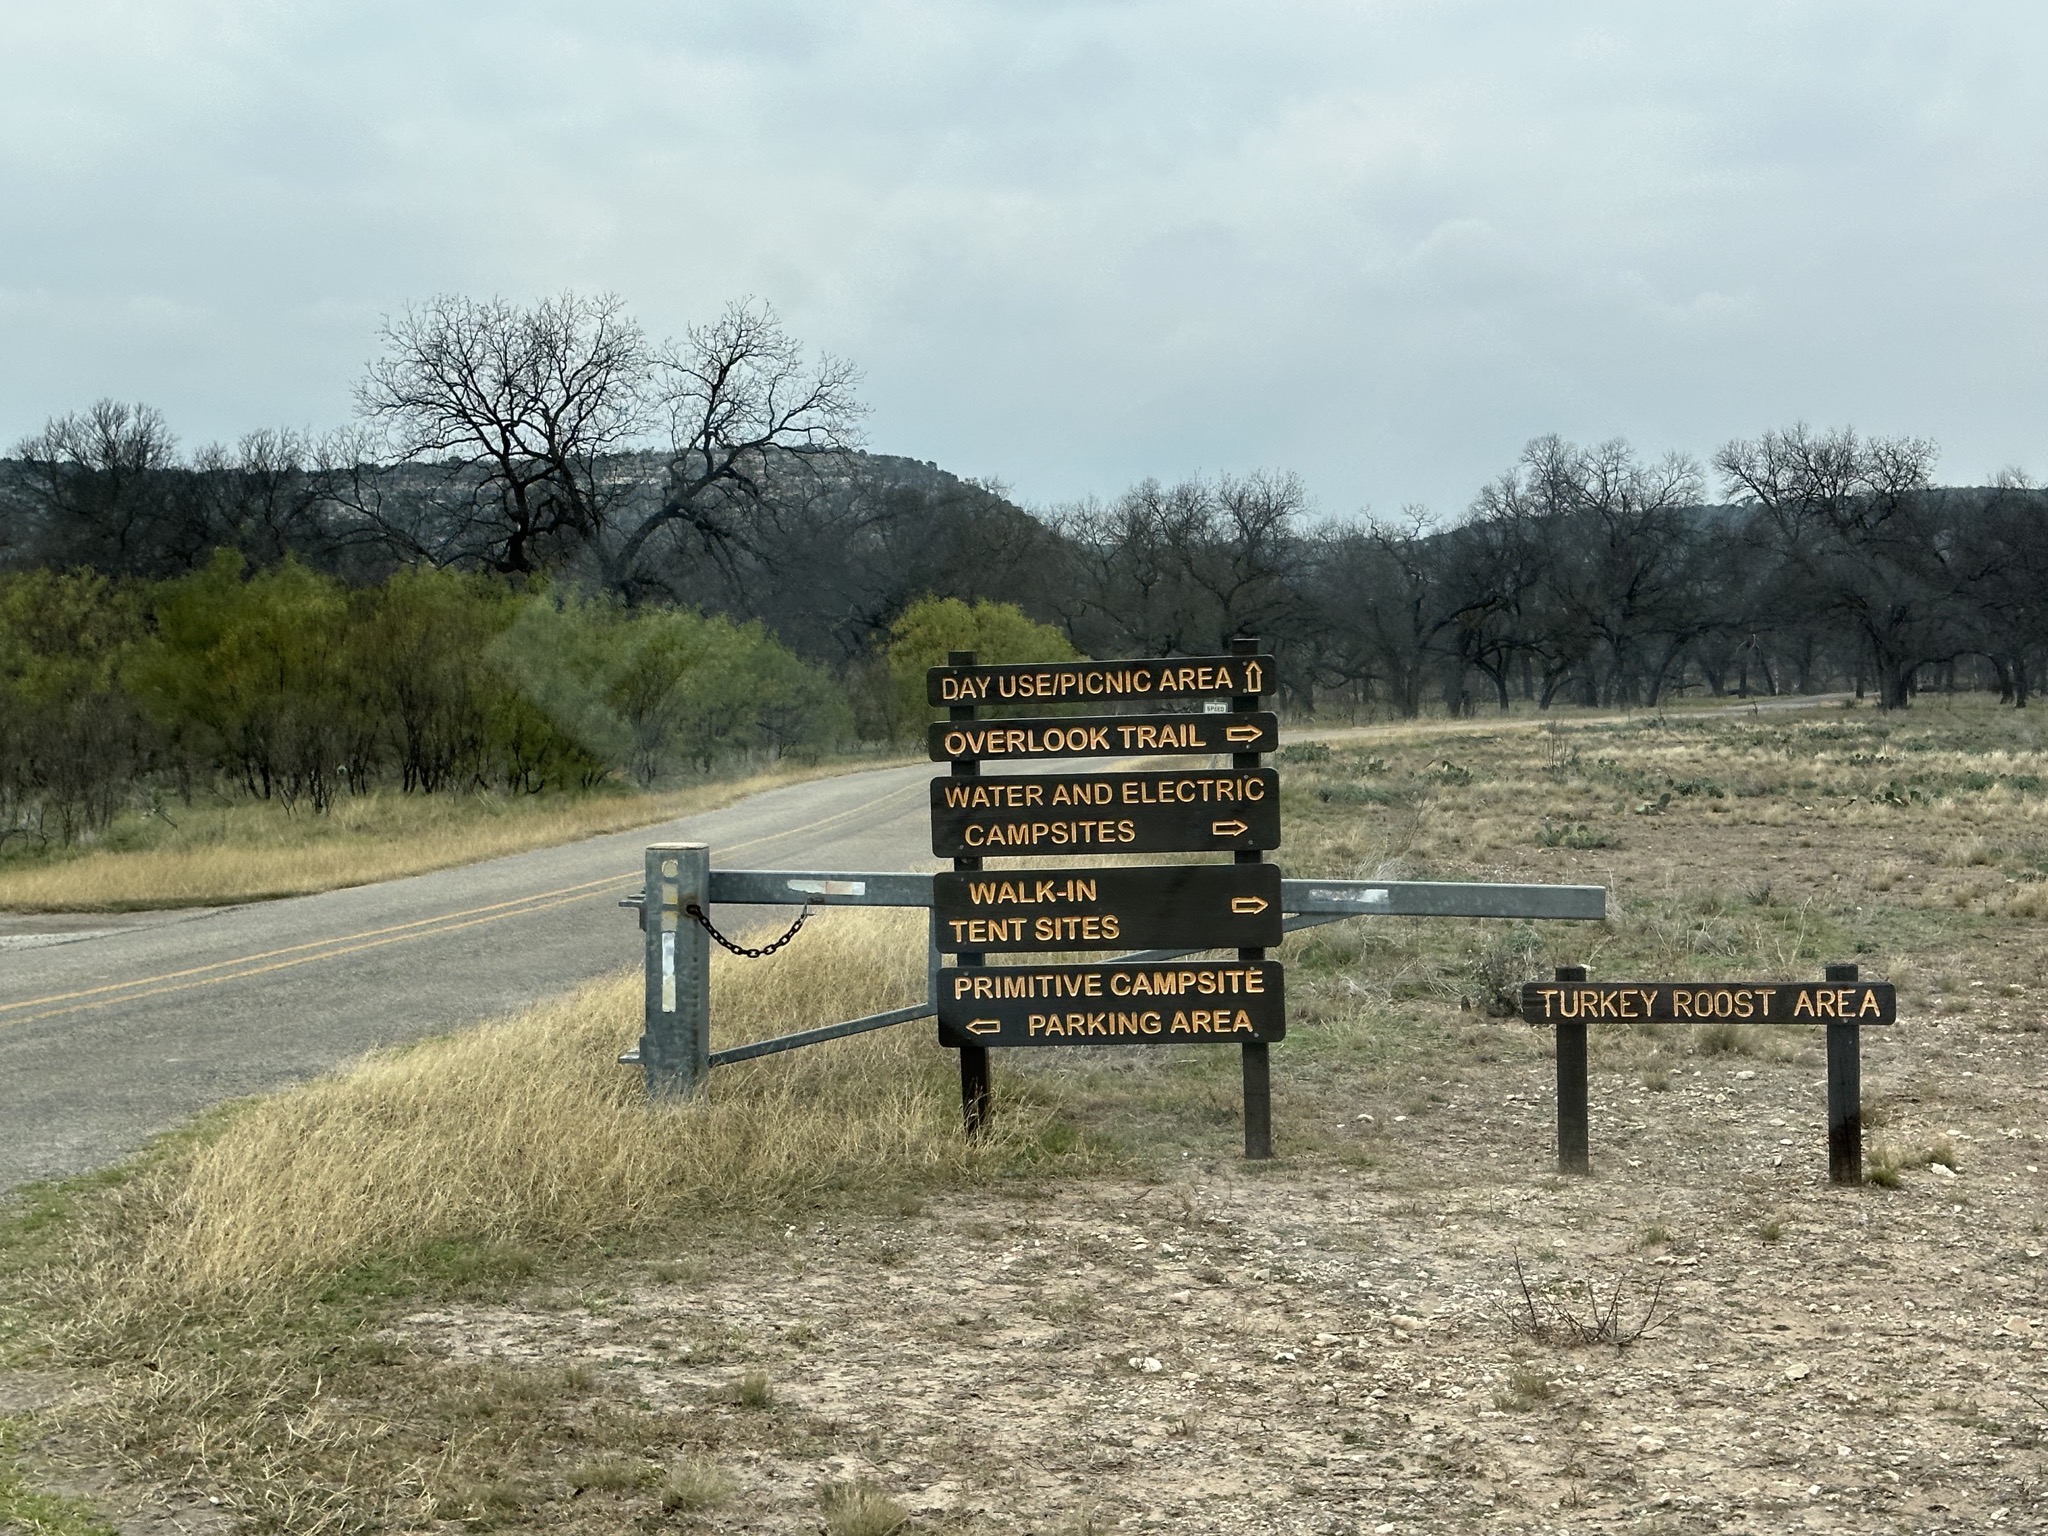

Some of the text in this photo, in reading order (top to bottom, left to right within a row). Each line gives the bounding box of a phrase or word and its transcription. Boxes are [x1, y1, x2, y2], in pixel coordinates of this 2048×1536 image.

[942, 667, 1233, 700] DAY USE/PICNIC AREA
[944, 724, 1206, 756] OVERLOOK TRAIL
[945, 778, 1265, 808] WATER AND ELECTRIC
[965, 820, 1136, 847] CAMPSITES
[969, 879, 1097, 905] WALK-IN
[949, 915, 1120, 943] TENT SITES
[954, 969, 1265, 999] PRIMITIVE CAMPSITE
[1536, 989, 1881, 1018] TURKEY ROOST AREA
[1028, 1010, 1254, 1036] PARKING AREA
